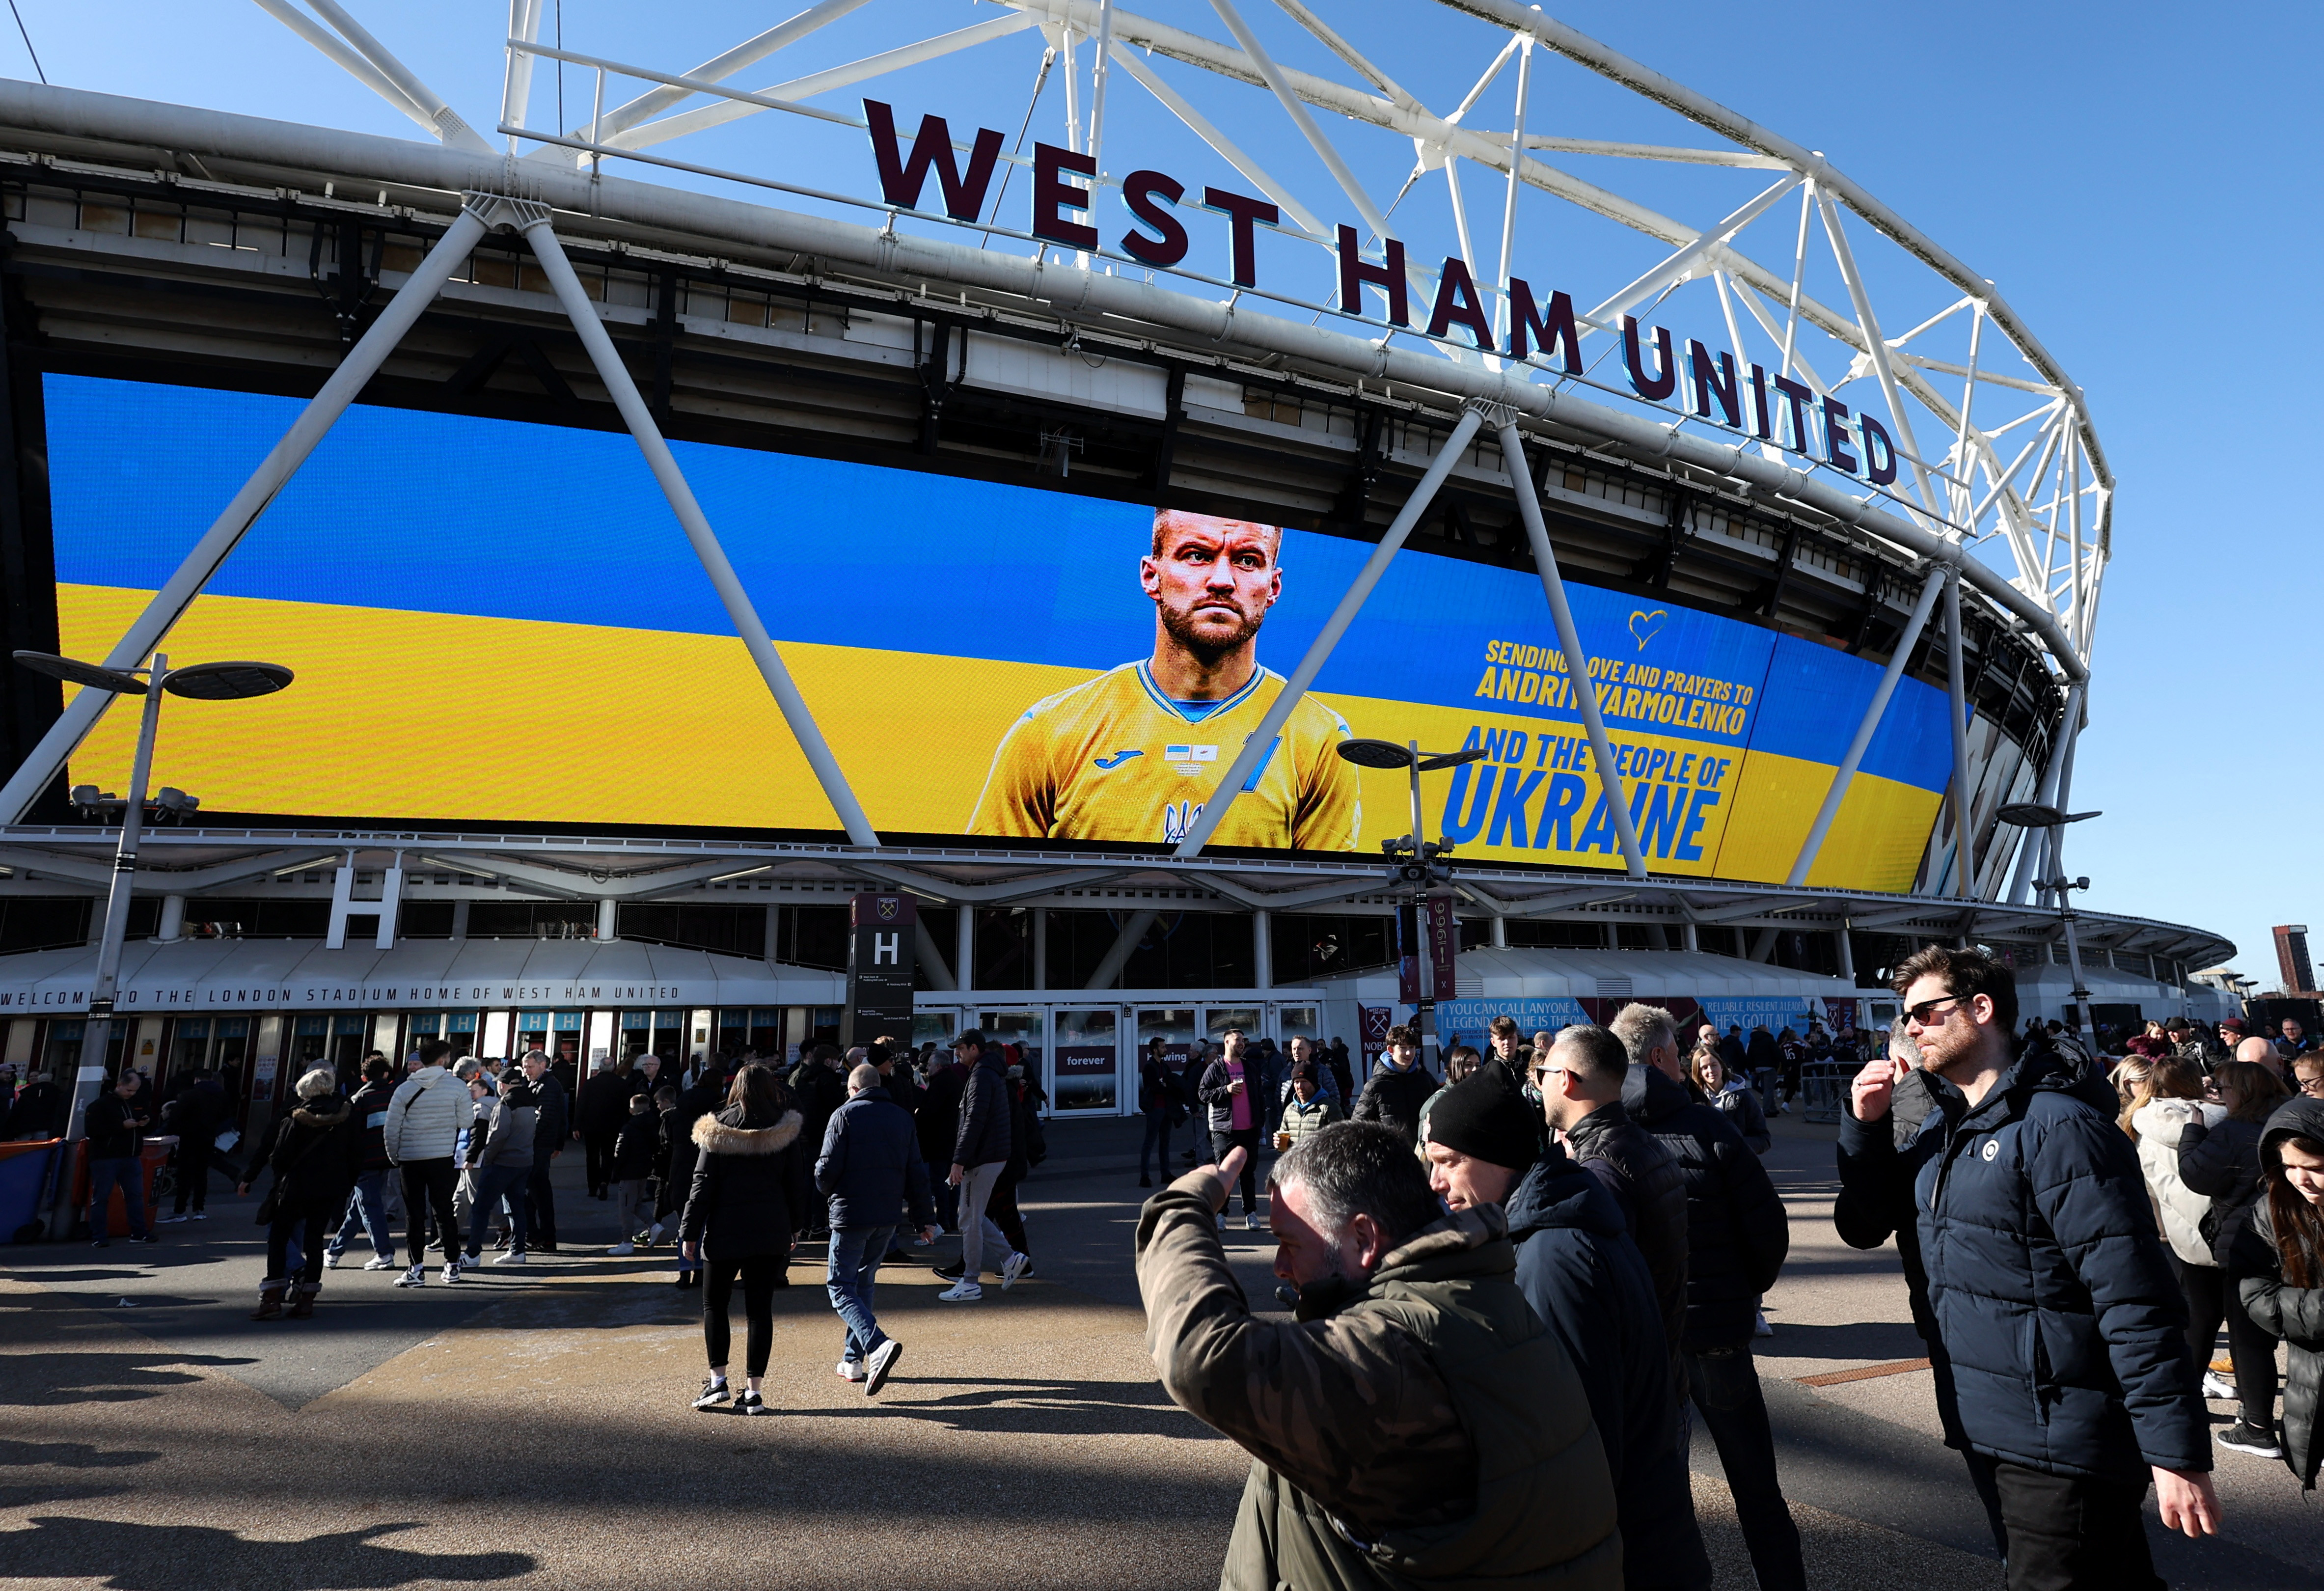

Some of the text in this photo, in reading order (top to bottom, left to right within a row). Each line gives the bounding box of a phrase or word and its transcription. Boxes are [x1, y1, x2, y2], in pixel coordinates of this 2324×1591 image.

[861, 97, 1897, 486] WEST HAM UNITED
[1485, 640, 1753, 706] SENDING OVE AND PRAYERS TO
[1595, 682, 1746, 736] YARMOLENKO
[1459, 725, 1528, 764] AND
[1537, 734, 1590, 772] THE
[1697, 756, 1732, 788] OF
[1441, 762, 1722, 862] UKRAINE
[326, 867, 404, 949] H
[849, 933, 855, 966] H
[875, 933, 898, 964] H
[1795, 935, 1802, 955] 6
[115, 990, 137, 1003] TO
[156, 990, 193, 1003] THE
[209, 989, 291, 1002] LONDON
[307, 988, 397, 1001] STADIUM
[410, 988, 461, 1000] HOME
[473, 988, 491, 999] OF
[503, 987, 550, 999] WEST
[565, 987, 601, 998] HAM
[615, 987, 678, 998] UNITED
[1437, 1002, 1579, 1015] IF YOU CAN CALL ANYONE A
[1780, 1001, 1784, 1012] A
[1784, 1001, 1806, 1011] LEADER
[421, 1017, 433, 1031] H
[457, 1016, 469, 1030] H
[529, 1015, 541, 1029] H
[563, 1015, 574, 1029] H
[631, 1015, 642, 1027] H
[664, 1014, 675, 1027] H
[1446, 1016, 1490, 1029] LEGEND
[1523, 1015, 1536, 1027] HE
[1538, 1015, 1548, 1027] IS
[1550, 1015, 1569, 1026] THE
[1570, 1015, 1589, 1025] ONE
[1742, 1014, 1765, 1029] GOT
[1364, 1042, 1385, 1051] NOB
[1067, 1056, 1105, 1066] forever
[1784, 1048, 1796, 1060] 16
